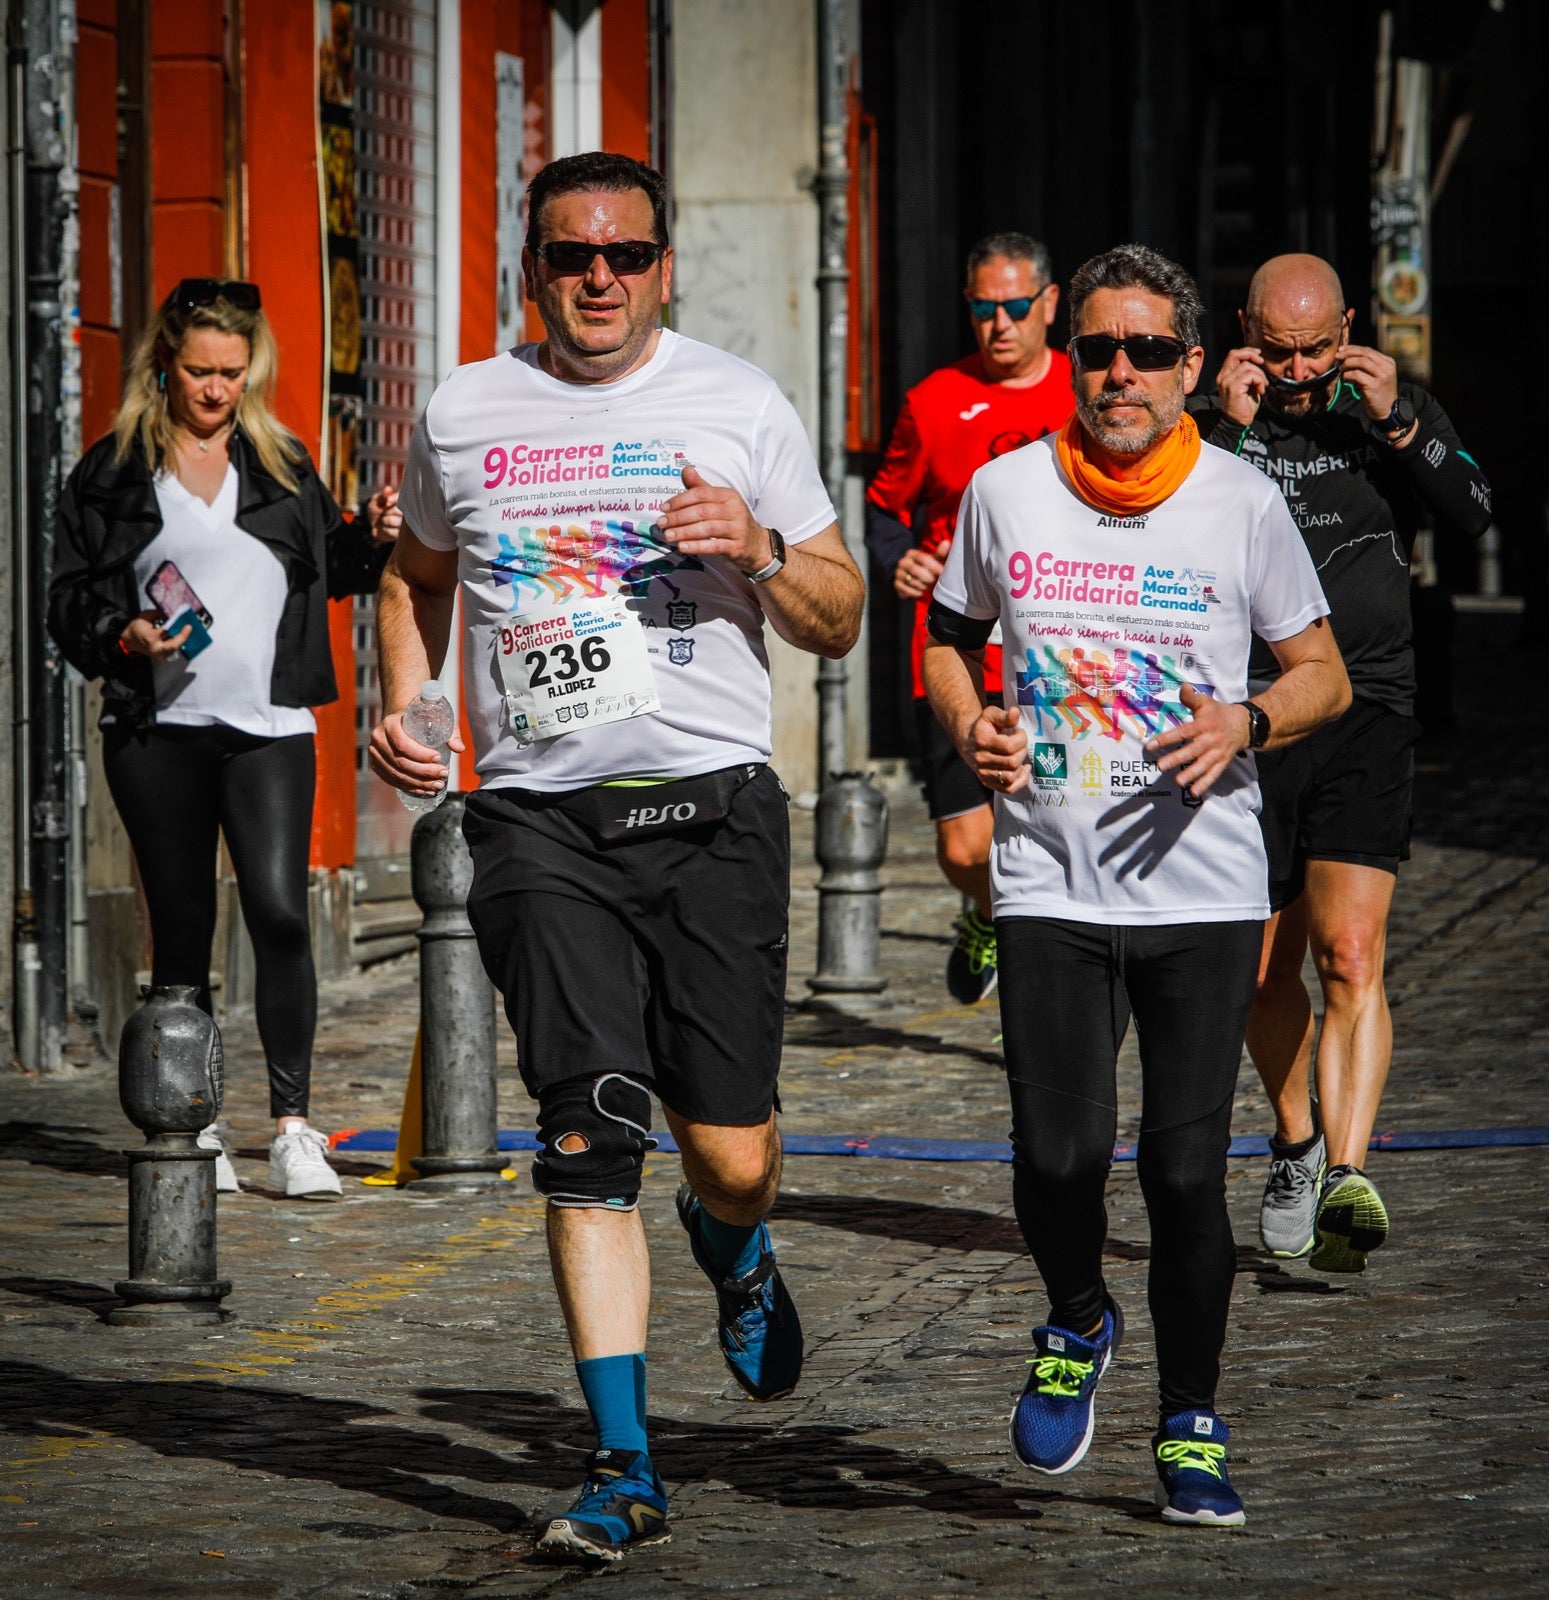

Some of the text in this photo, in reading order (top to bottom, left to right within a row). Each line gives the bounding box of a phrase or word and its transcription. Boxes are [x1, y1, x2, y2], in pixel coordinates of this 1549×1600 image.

[511, 443, 604, 465] Carrera
[613, 441, 643, 451] Ave
[483, 446, 508, 489] 9
[612, 451, 657, 464] María
[508, 459, 610, 487] Solidaria
[611, 464, 682, 478] Granada
[500, 495, 528, 504] carrera
[530, 492, 548, 500] más
[579, 488, 587, 497] el
[589, 486, 626, 496] esfuerzo
[627, 484, 647, 494] más
[501, 503, 548, 520] Mirando
[551, 502, 596, 517] siempre
[598, 500, 631, 512] hacia
[634, 498, 645, 511] lo
[1097, 516, 1146, 529] Altium
[1008, 550, 1033, 600] 9
[1035, 551, 1136, 582] Carrera
[1144, 565, 1175, 580] Ave
[1033, 576, 1140, 607] Solidaria
[1142, 580, 1188, 596] María
[1140, 595, 1208, 613] Granada
[572, 610, 592, 620] Ave
[573, 616, 605, 628] María
[1026, 610, 1054, 618] carrera
[1055, 611, 1075, 619] más
[1107, 613, 1115, 622] el
[1116, 614, 1154, 626] esfuerzo
[1154, 619, 1174, 628] más
[513, 616, 567, 639] Carrera
[574, 621, 622, 636] Granada
[1028, 622, 1194, 648] Mirando siempre hacia lo alto
[501, 628, 514, 655] 9
[515, 628, 575, 652] Solidaria
[525, 635, 612, 689] 236
[548, 677, 596, 699] A.LOPEZ
[1111, 775, 1153, 787] REAL
